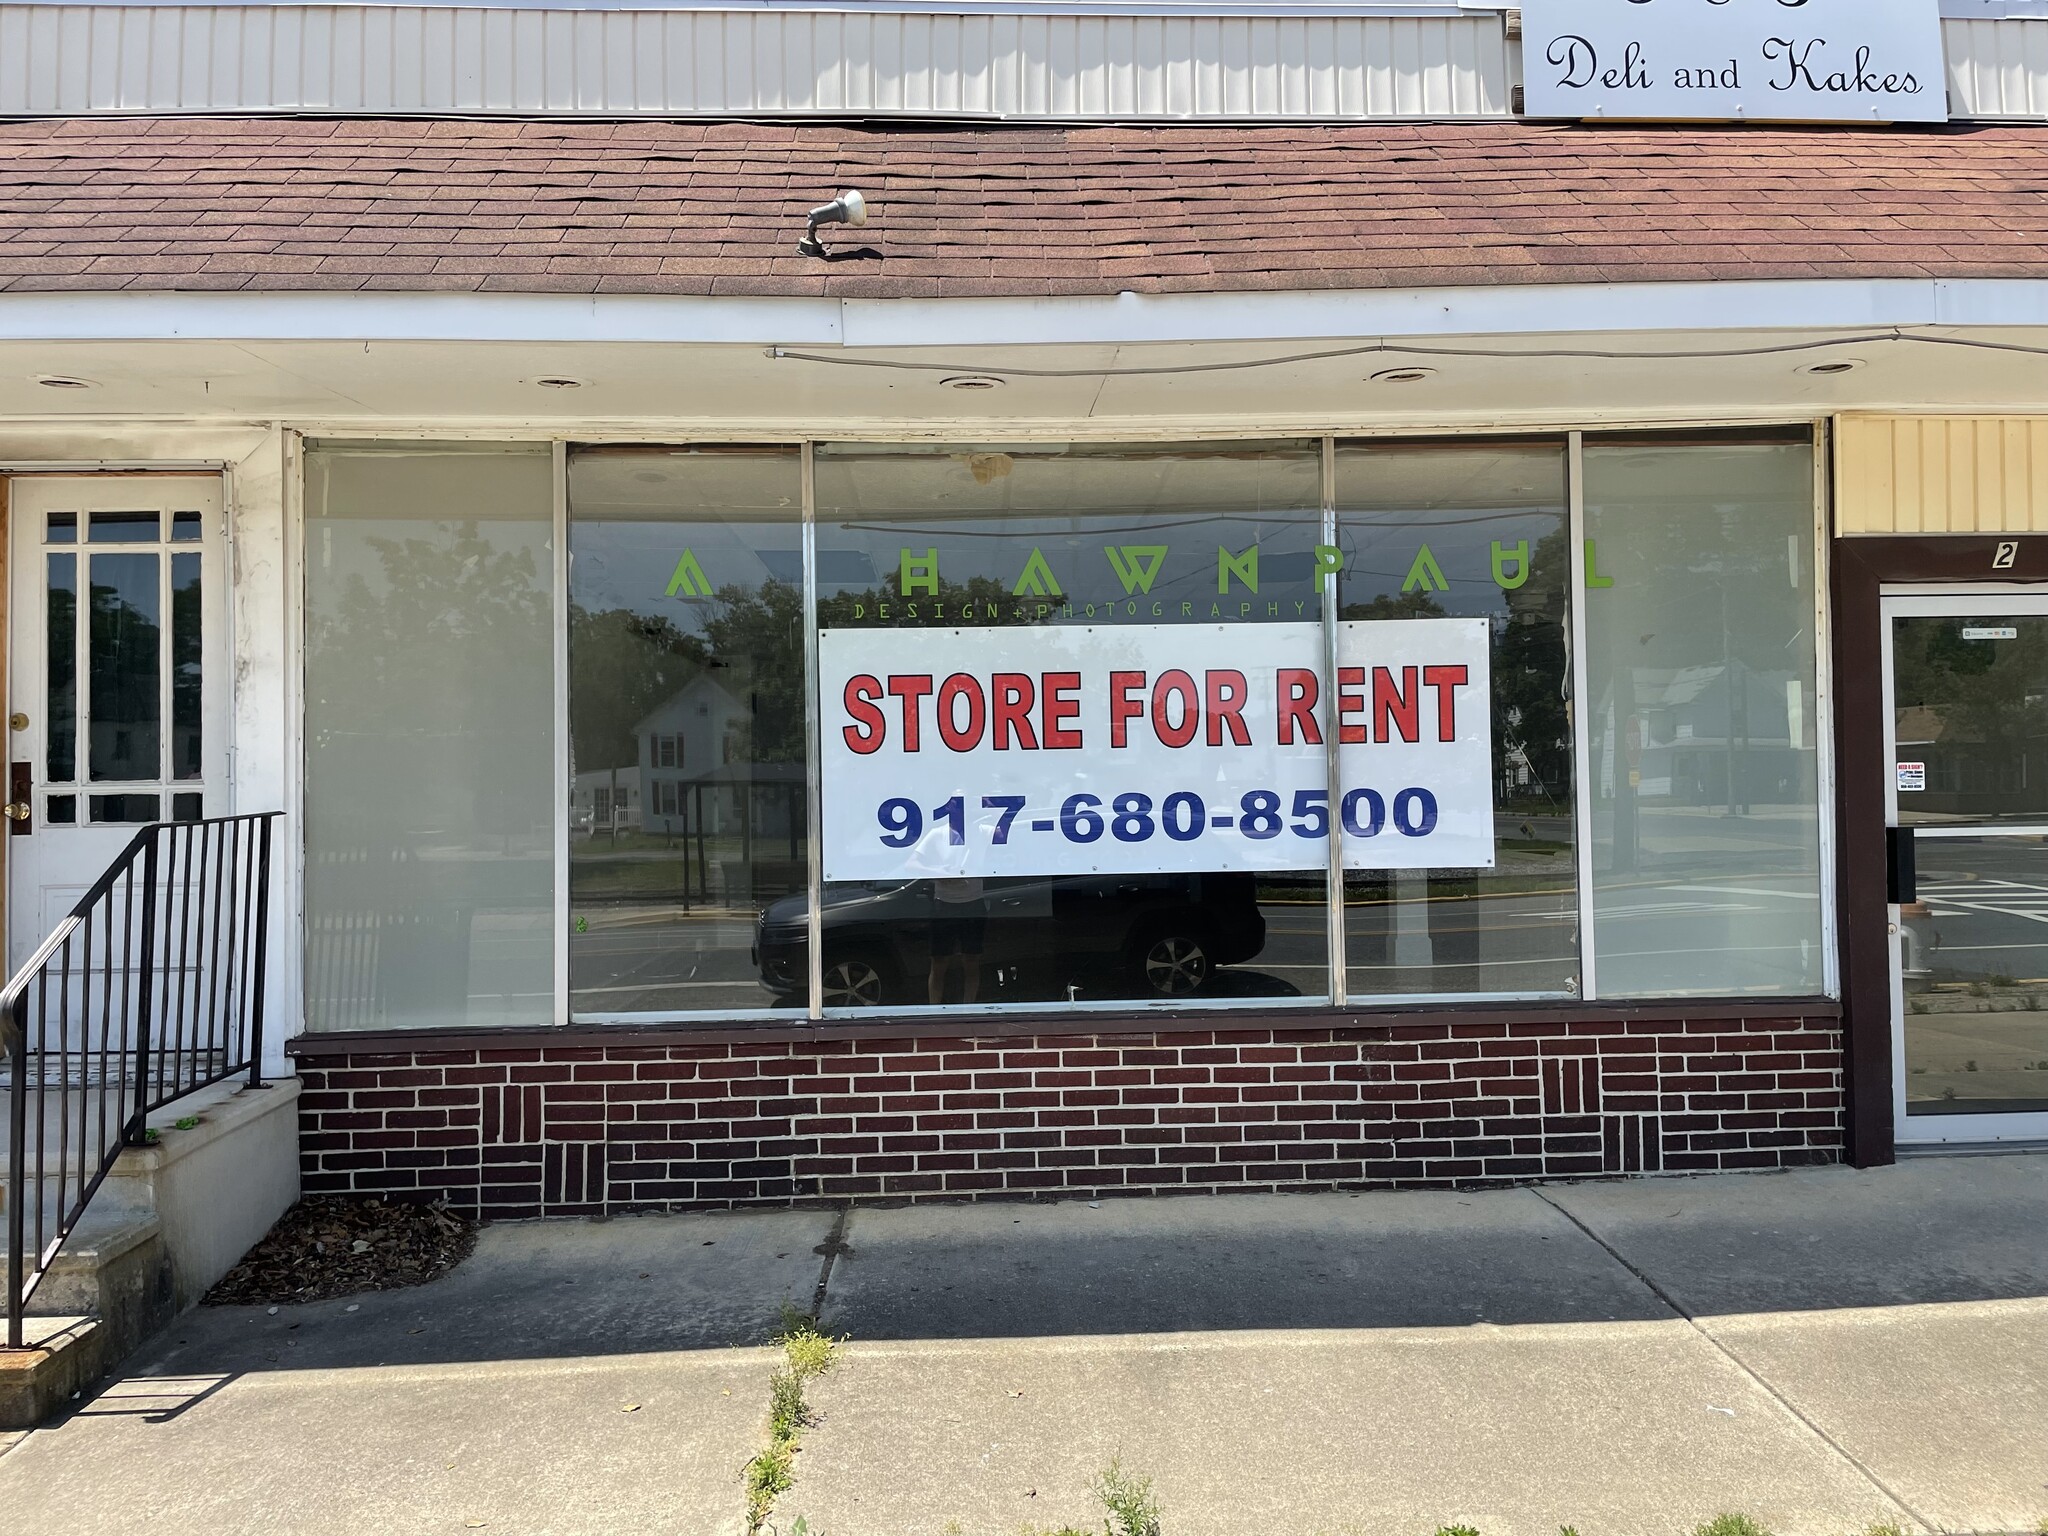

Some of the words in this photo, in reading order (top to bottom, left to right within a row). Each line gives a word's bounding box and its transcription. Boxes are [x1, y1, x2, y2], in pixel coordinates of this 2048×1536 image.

[1546, 35, 1653, 90] Deli
[1673, 59, 1741, 89] and
[1762, 37, 1924, 94] Kakes
[1996, 543, 2014, 566] 2
[842, 672, 1084, 755] STORE
[1110, 668, 1253, 750] FOR
[1276, 664, 1469, 746] RENT
[877, 786, 1439, 849] 917-680-8500
